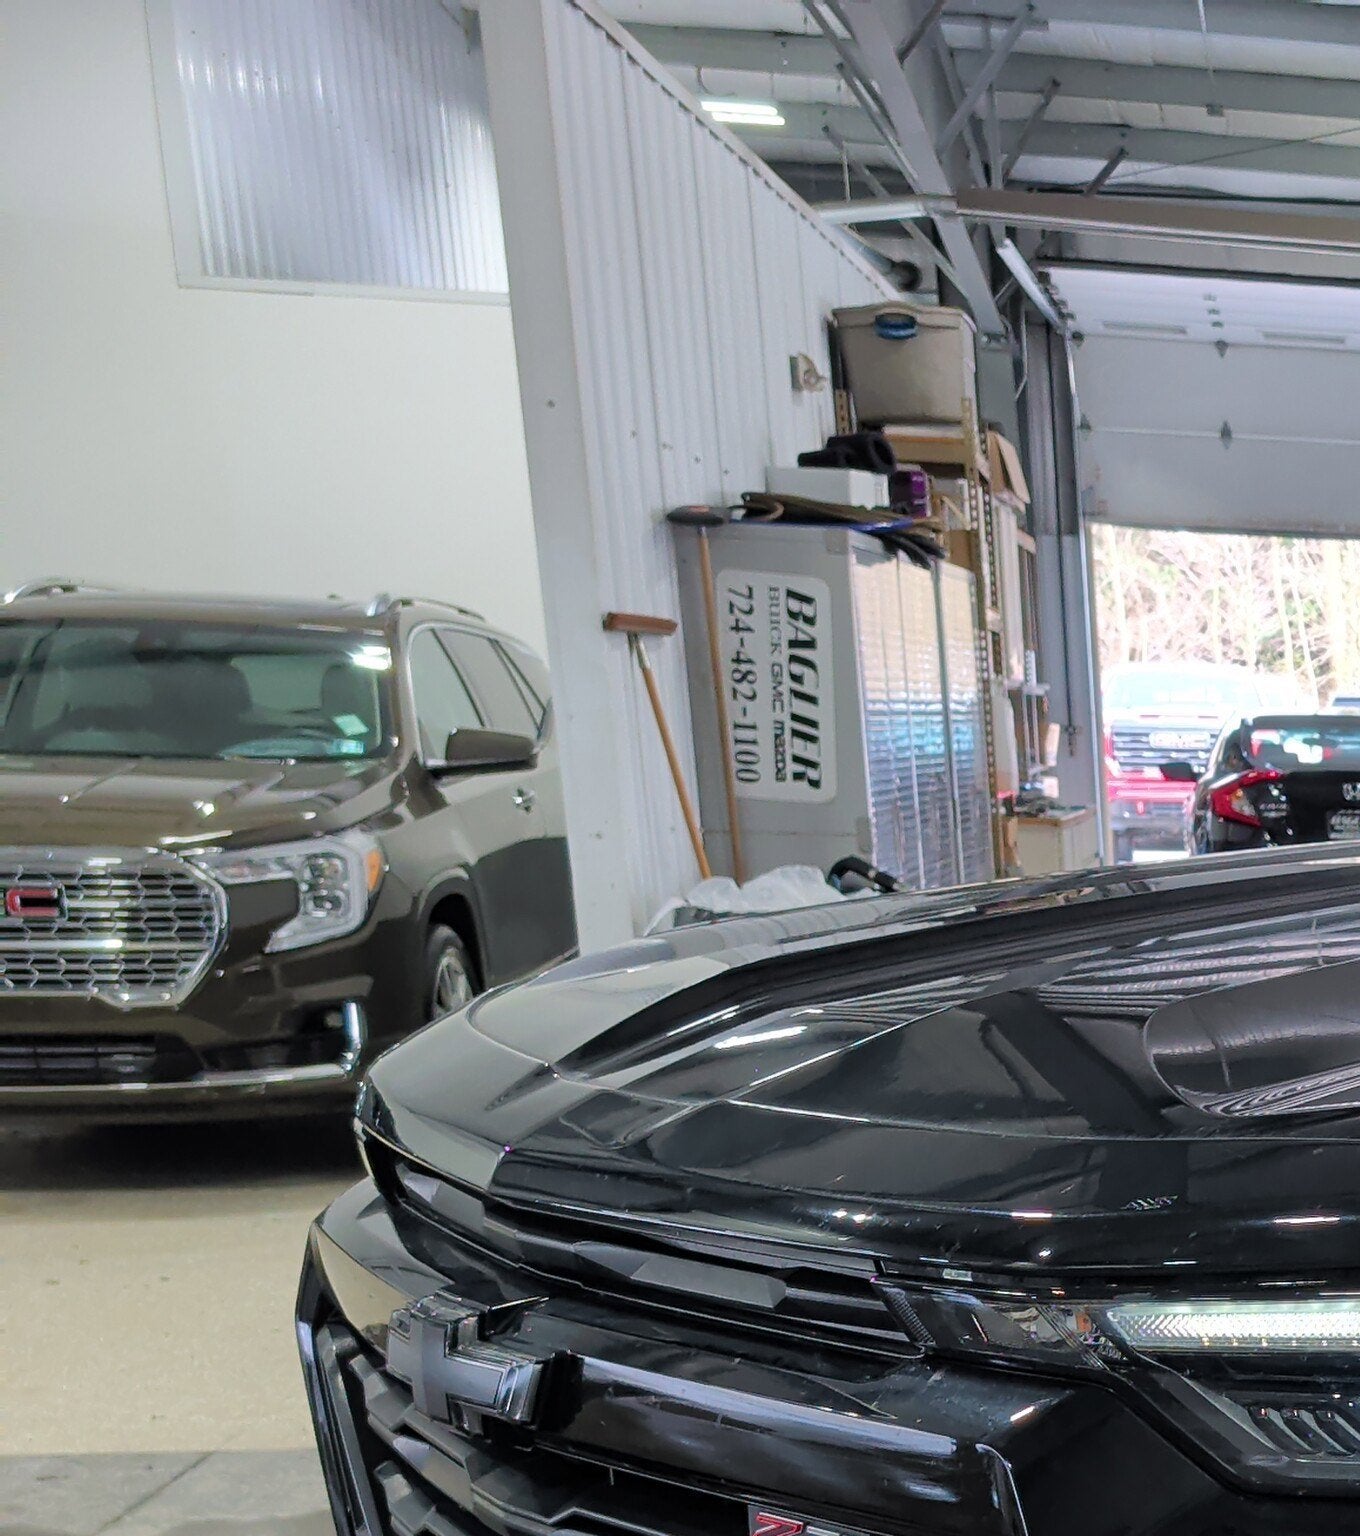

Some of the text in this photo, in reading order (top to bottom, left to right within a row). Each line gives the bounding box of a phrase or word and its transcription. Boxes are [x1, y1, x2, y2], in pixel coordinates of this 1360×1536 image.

[727, 584, 762, 784] 724-482-1100
[768, 585, 783, 654] BUICK
[771, 662, 785, 714] GMC
[786, 586, 823, 790] BAGLIER
